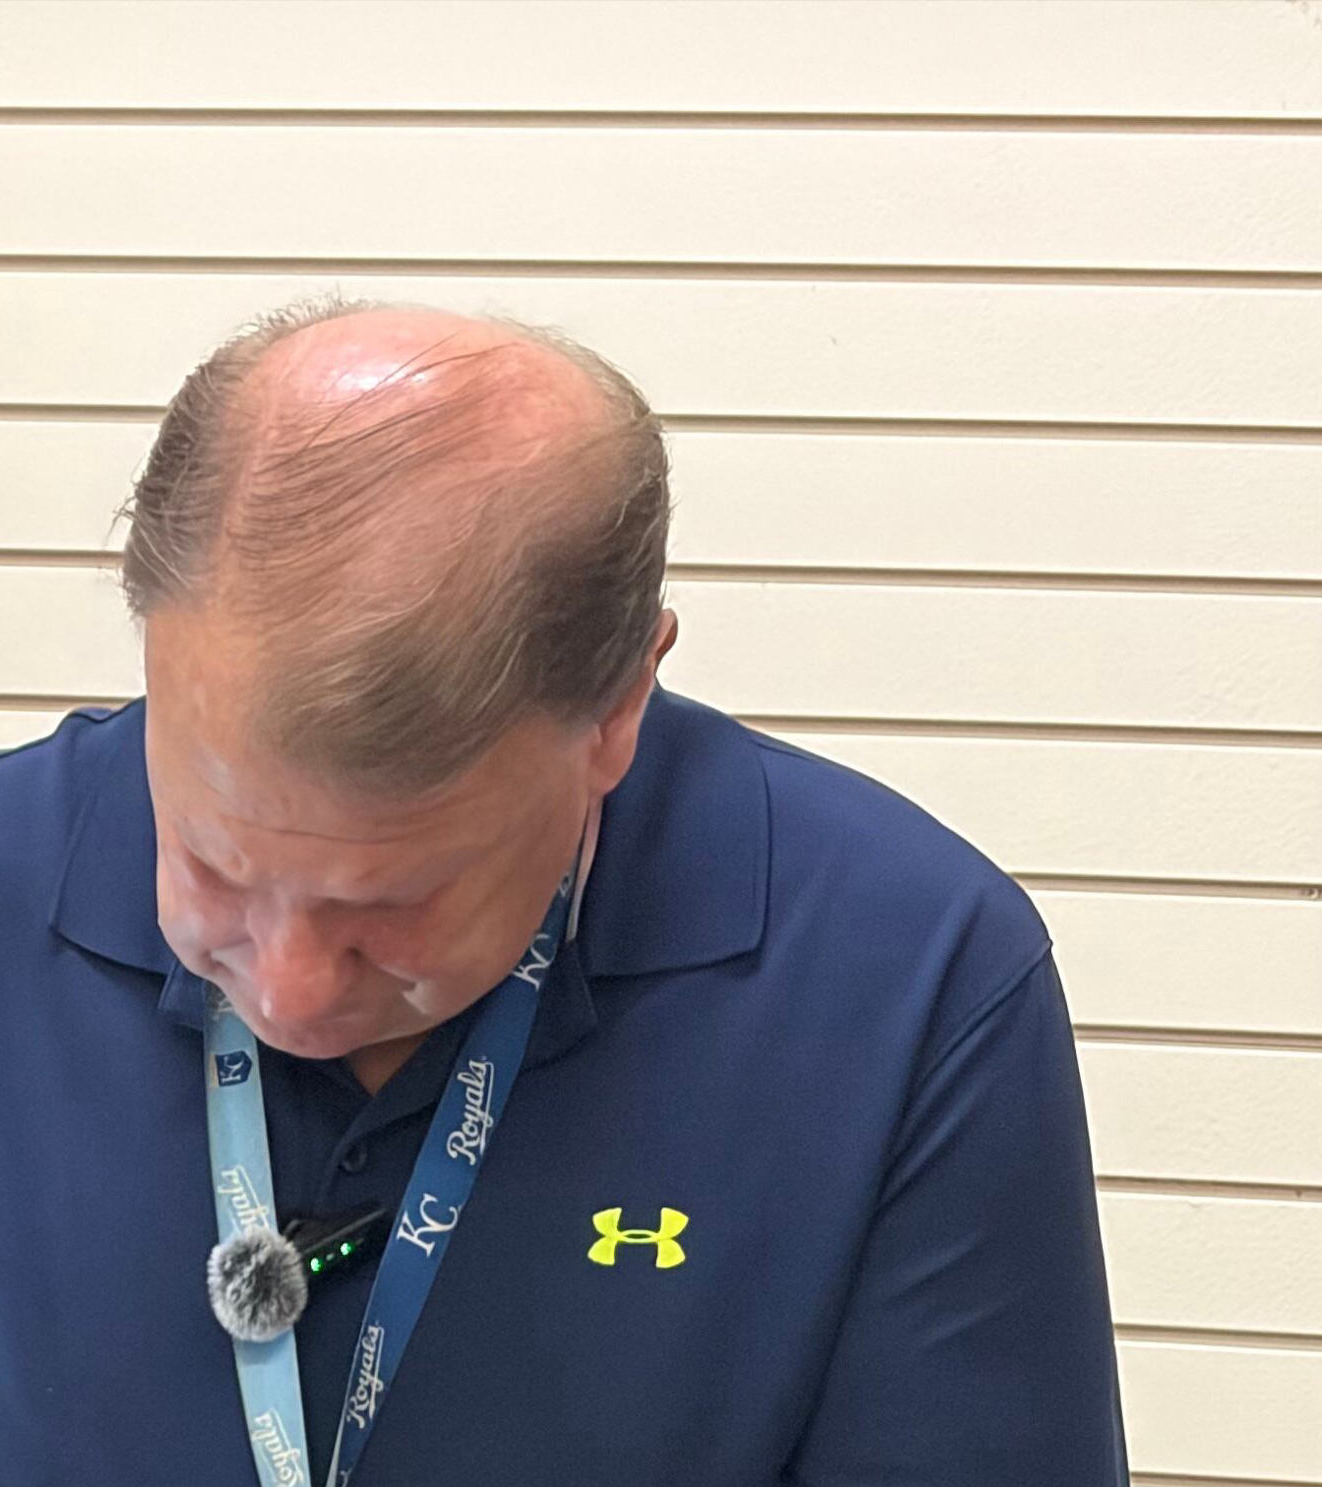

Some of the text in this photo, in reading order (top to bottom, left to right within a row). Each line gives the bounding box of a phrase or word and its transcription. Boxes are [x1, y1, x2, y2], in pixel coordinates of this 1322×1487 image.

[447, 1057, 495, 1166] Royals
[397, 1194, 463, 1257] KC
[347, 1322, 385, 1429] Royals
